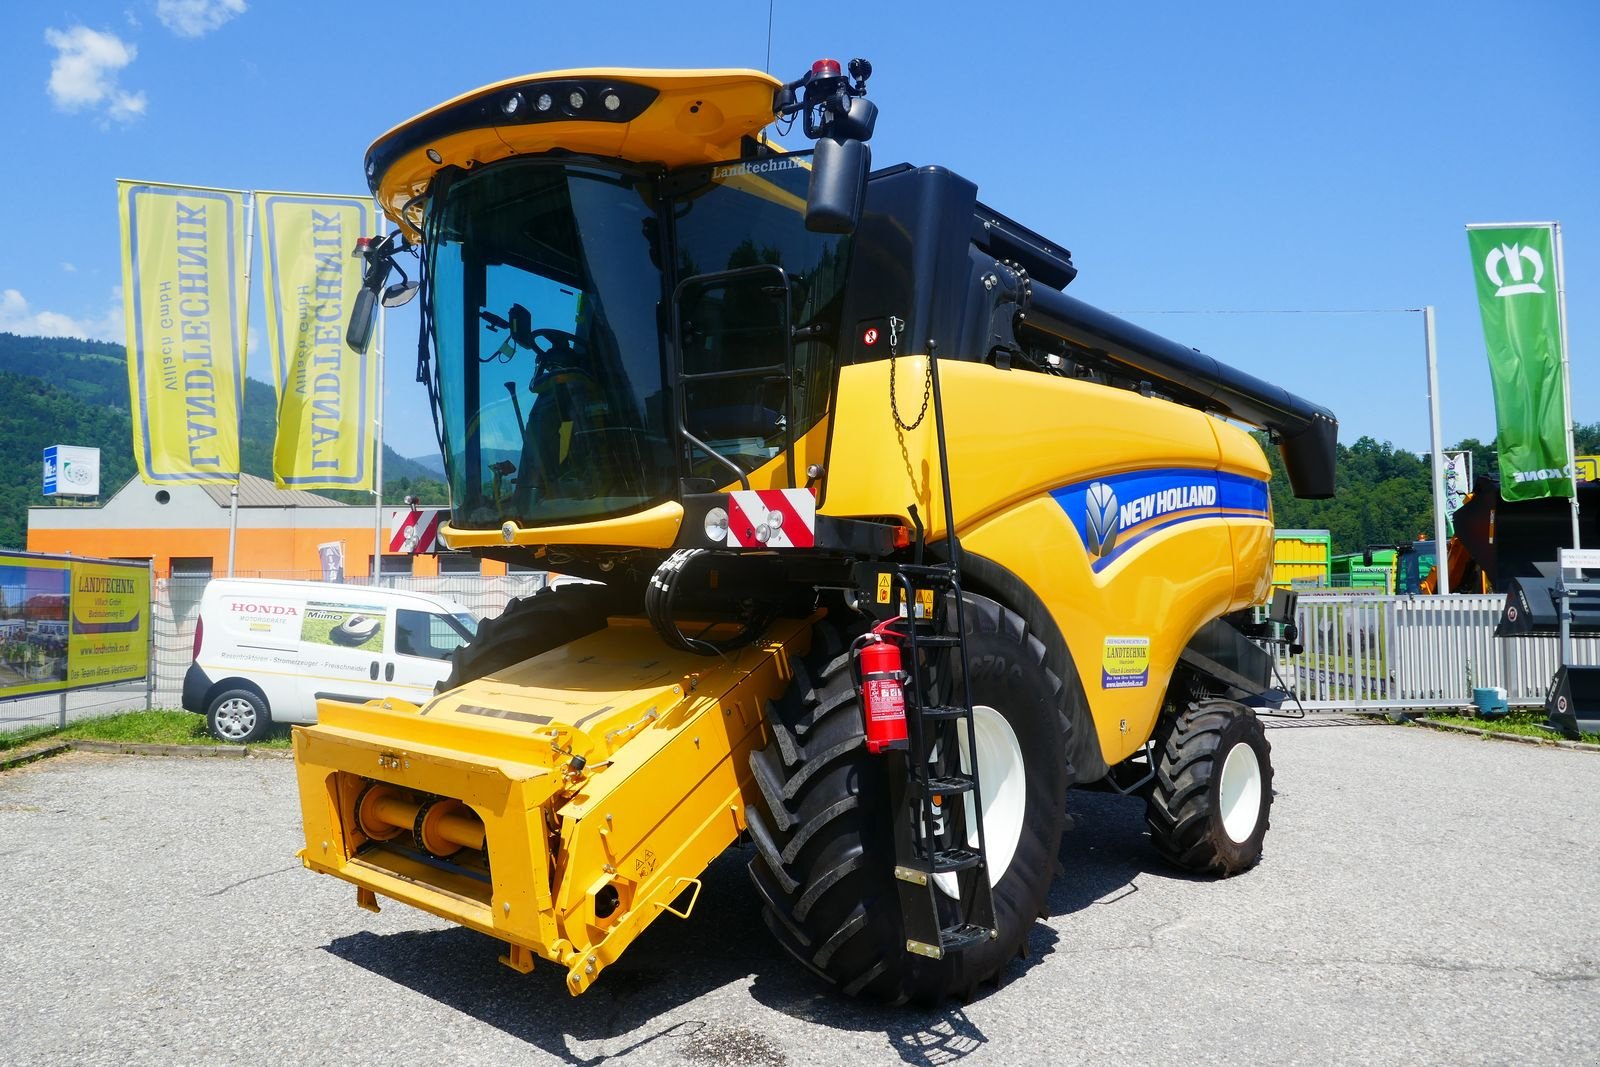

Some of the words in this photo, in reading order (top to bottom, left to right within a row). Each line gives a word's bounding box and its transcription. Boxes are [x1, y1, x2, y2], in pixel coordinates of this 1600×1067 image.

[1119, 493, 1157, 530] NEW
[1156, 485, 1217, 515] HOLLAND
[79, 576, 135, 594] LANDTECHNIK
[231, 603, 298, 616] HONDA
[307, 611, 343, 621] Miimo
[1107, 647, 1147, 659] LANDTECHNIK
